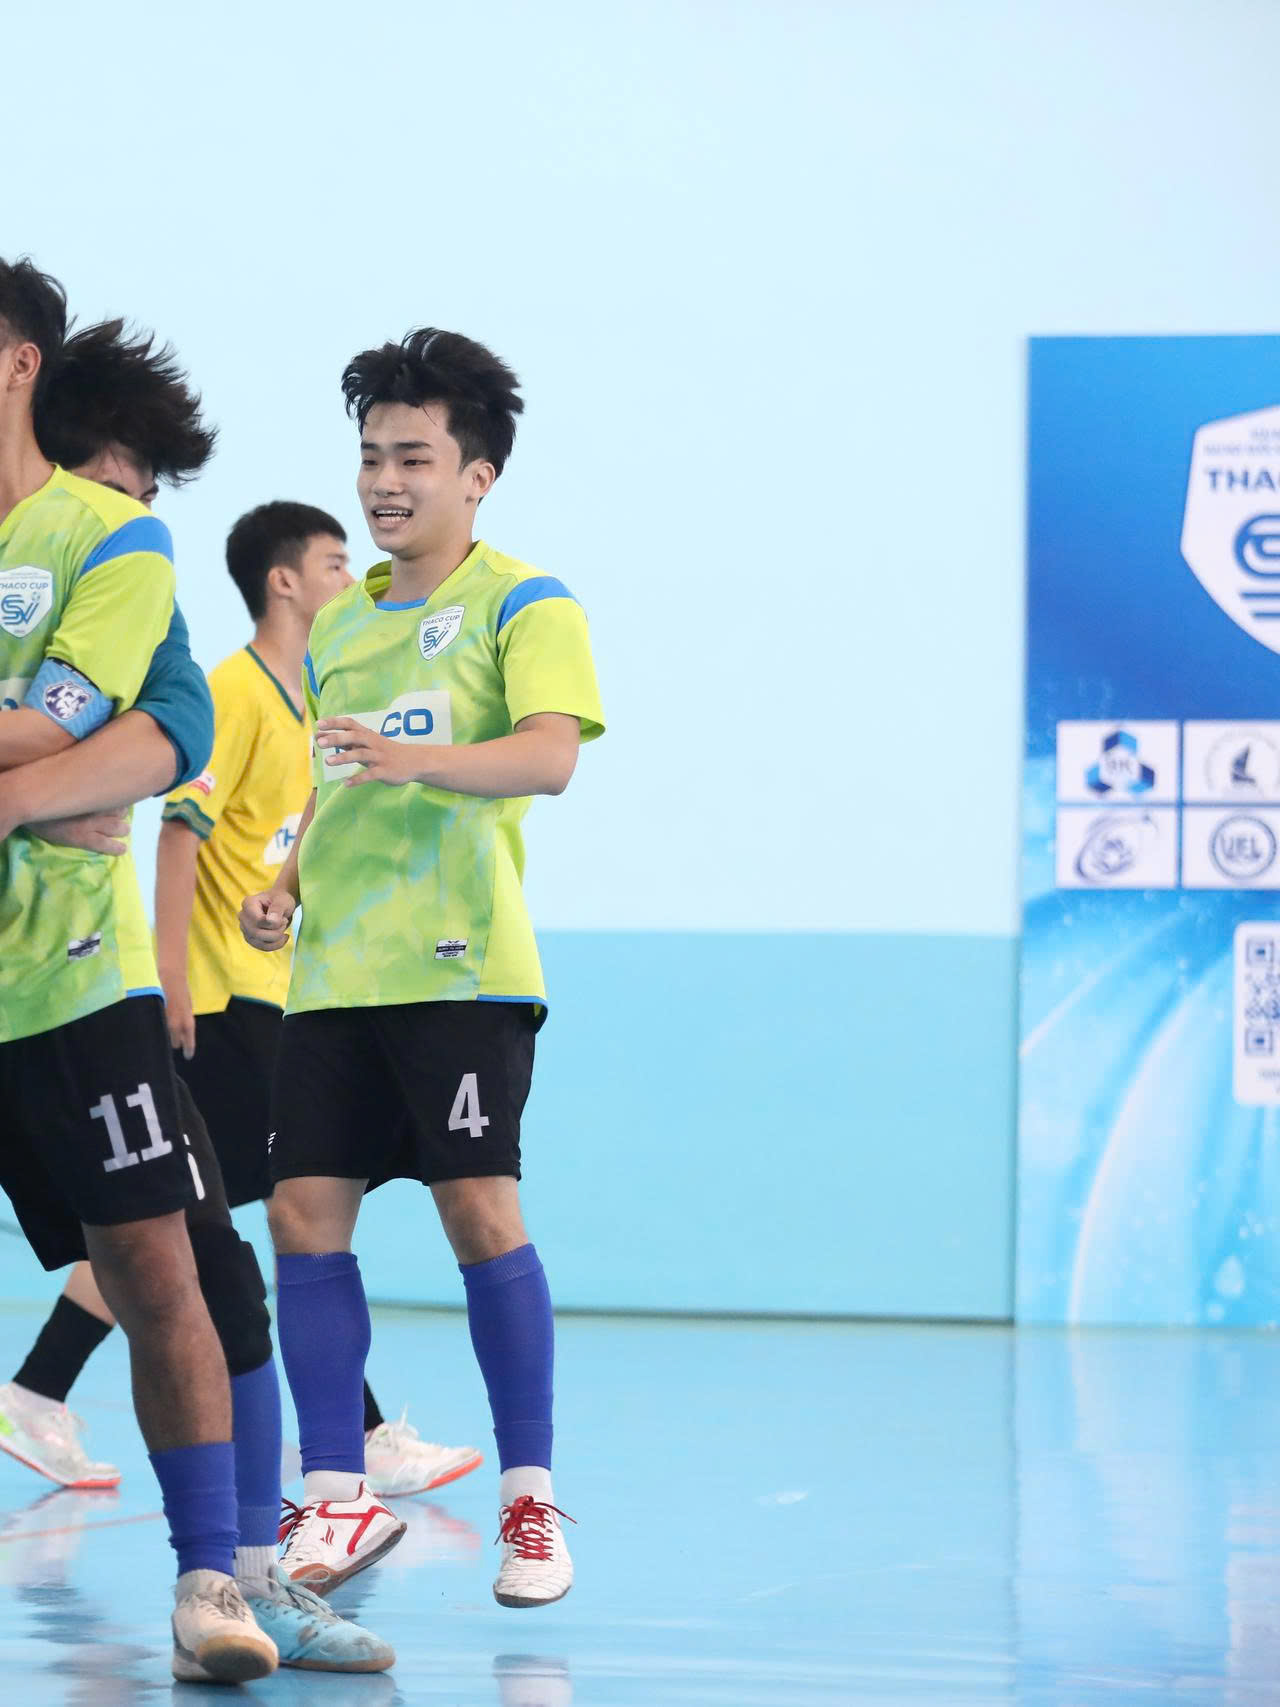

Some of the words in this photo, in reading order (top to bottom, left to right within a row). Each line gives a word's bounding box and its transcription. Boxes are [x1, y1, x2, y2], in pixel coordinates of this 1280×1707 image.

[1203, 467, 1280, 492] THA
[29, 582, 49, 590] CUP
[448, 1072, 490, 1138] 4
[89, 1083, 173, 1173] 11
